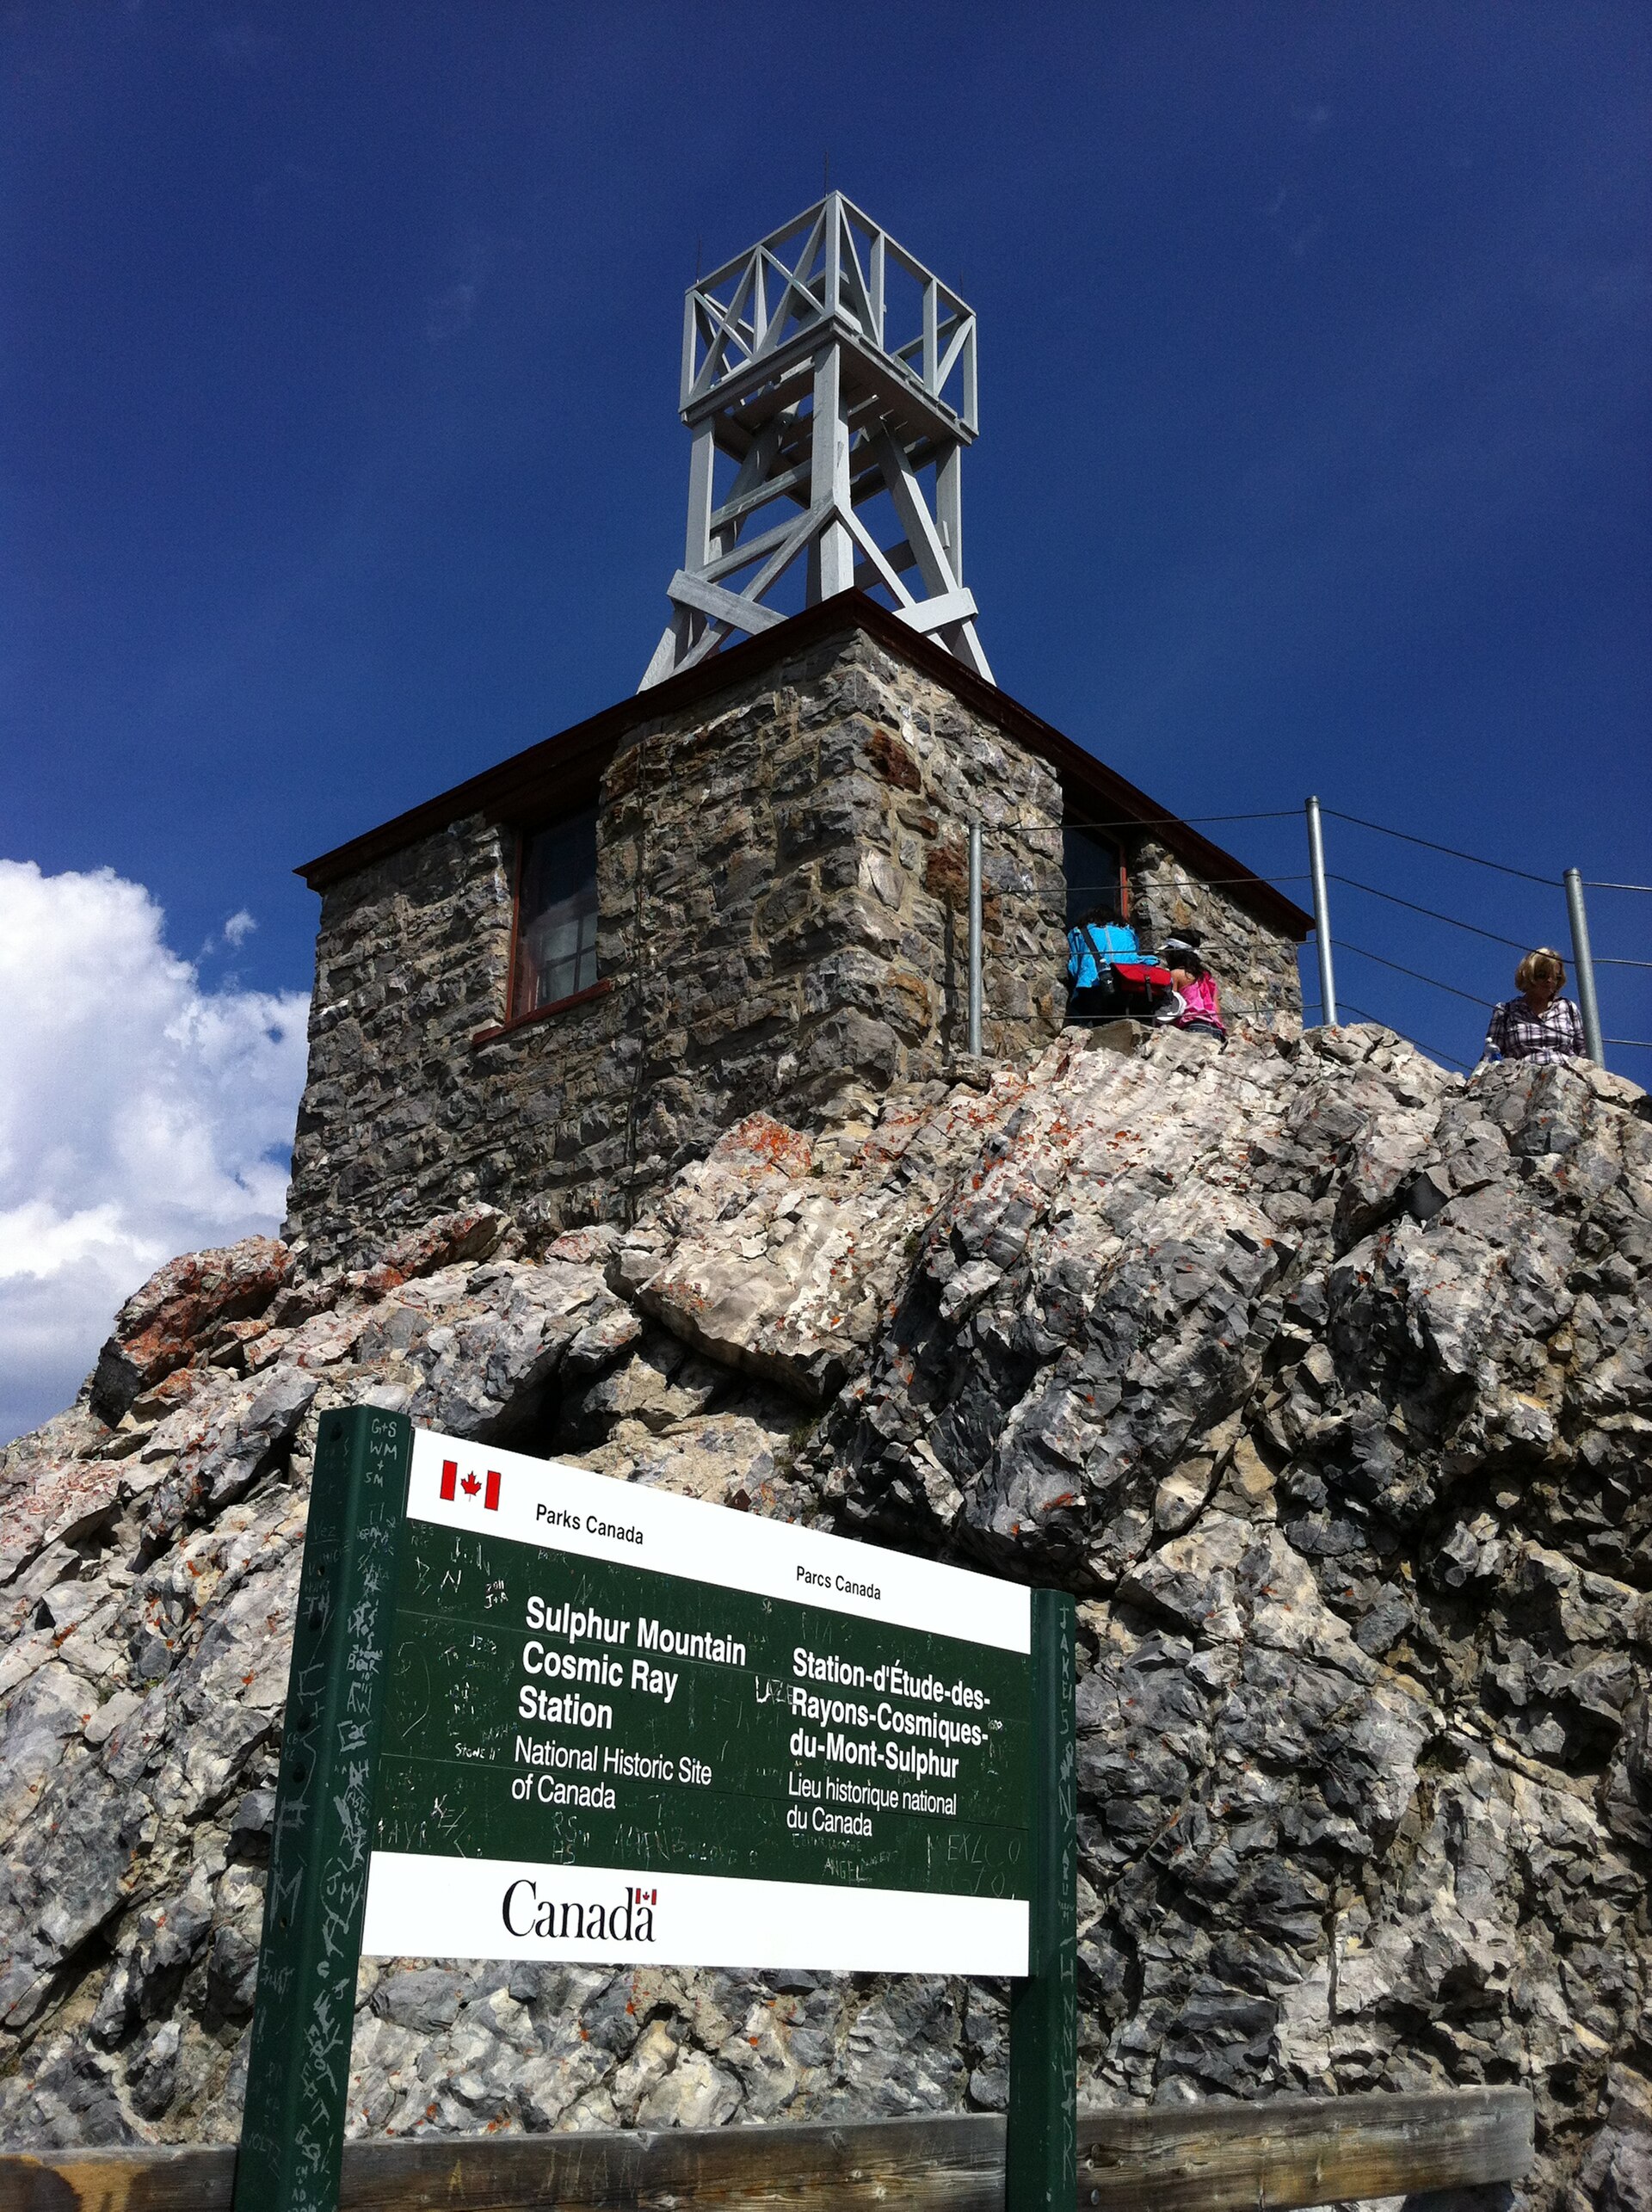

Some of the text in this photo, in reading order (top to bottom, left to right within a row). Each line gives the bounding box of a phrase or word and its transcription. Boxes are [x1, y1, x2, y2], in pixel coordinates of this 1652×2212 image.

[536, 1503, 644, 1545] Parks Canada
[796, 1565, 882, 1600] Parcs Canada
[527, 1595, 746, 1667] Sulphur Mountain
[523, 1641, 679, 1704] Cosmic Ray
[792, 1647, 990, 1710] Station-d'Étude-des-
[519, 1685, 613, 1729] Station
[792, 1686, 989, 1748] Rayons-Cosmiques-
[515, 1734, 713, 1785] National Historic Site
[790, 1727, 959, 1781] du-Mont-Sulphur
[511, 1772, 617, 1810] of Canada
[789, 1771, 957, 1815] Lieu historique national
[786, 1805, 872, 1837] du Canada
[502, 1879, 656, 1943] Canada
